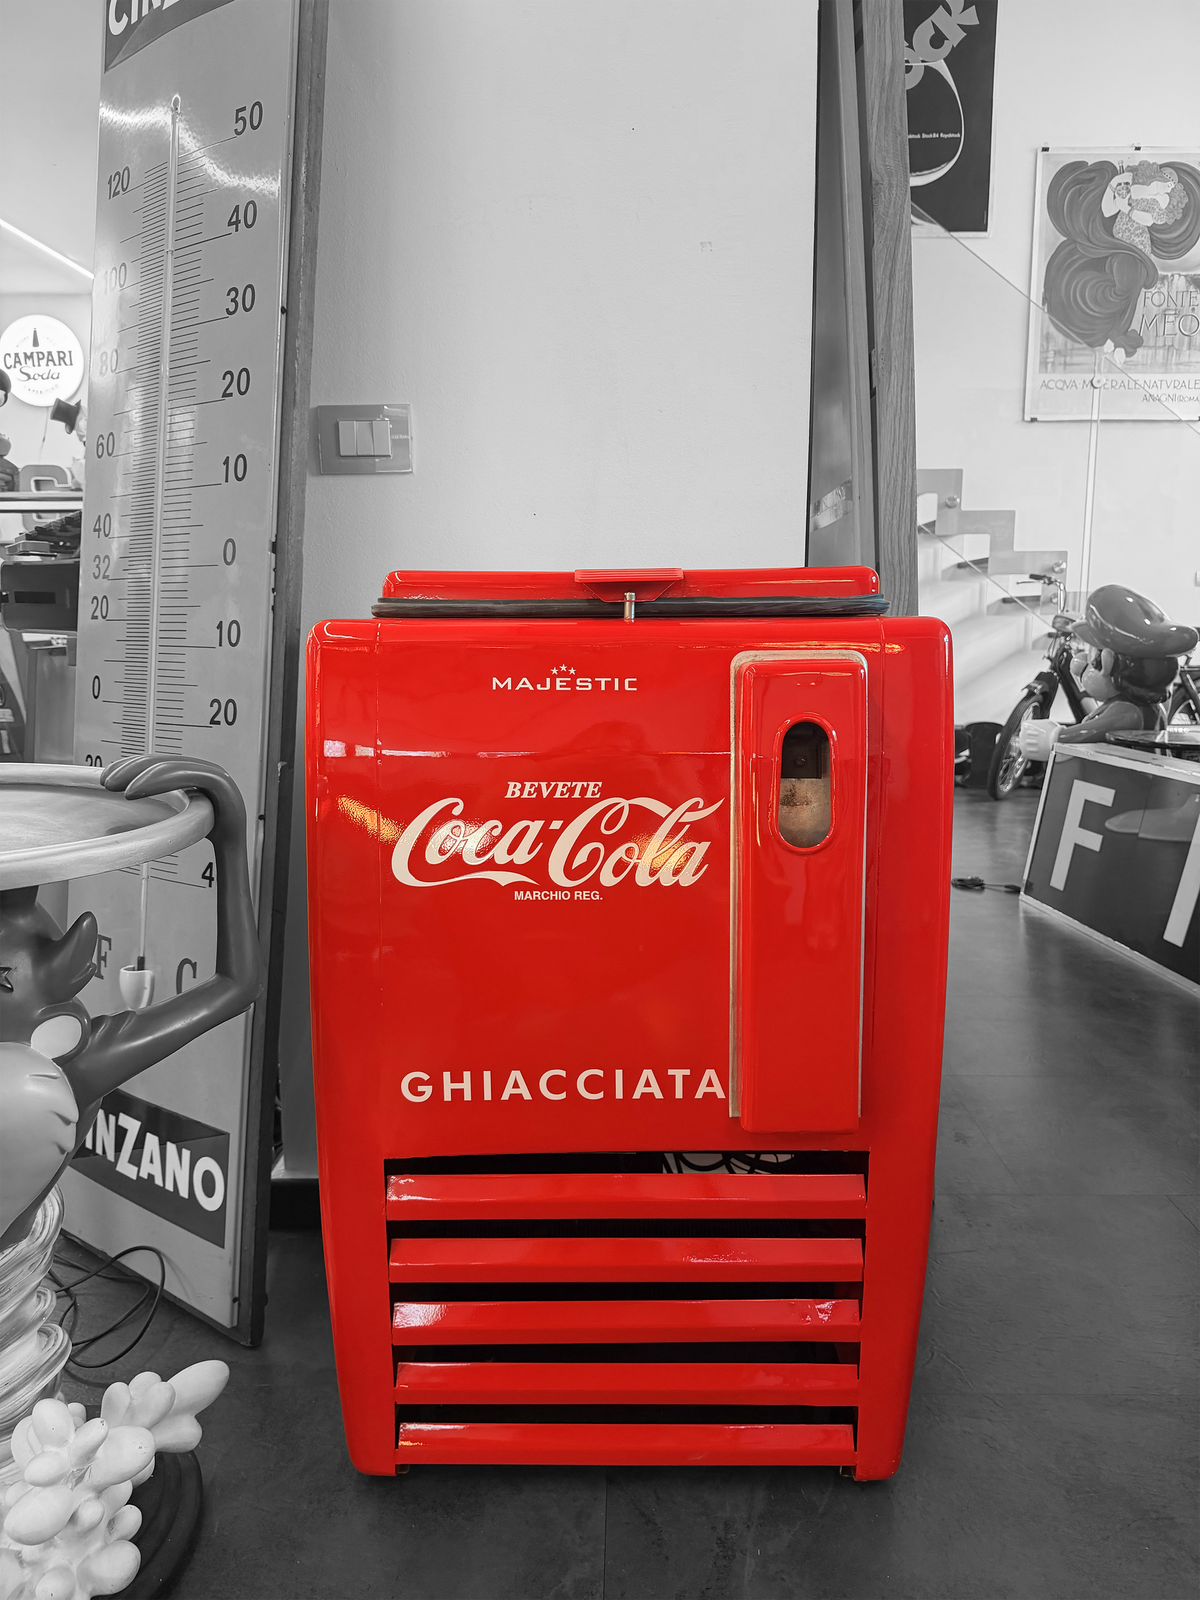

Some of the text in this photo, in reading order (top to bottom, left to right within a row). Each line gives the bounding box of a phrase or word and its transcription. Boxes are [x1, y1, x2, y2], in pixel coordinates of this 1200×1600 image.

[234, 101, 263, 136] 50
[108, 166, 130, 200] 120
[228, 200, 257, 233] 40
[226, 284, 256, 317] 30
[1143, 290, 1200, 308] FONTE
[3, 350, 73, 370] CAMPARI
[17, 366, 60, 382] Soda
[99, 347, 119, 378] 80
[221, 367, 251, 399] 20
[1081, 379, 1141, 391] MERALE
[96, 432, 115, 459] 60
[223, 454, 248, 483] 10
[93, 513, 112, 539] 40
[223, 538, 237, 566] 0
[92, 555, 111, 580] 32
[91, 595, 109, 620] 20
[216, 620, 241, 648] 10
[92, 675, 101, 700] 0
[492, 675, 638, 692] MAJESTIC
[209, 699, 238, 727] 20
[505, 781, 602, 799] BEVETE
[391, 796, 725, 887] Coca-Cola
[513, 889, 603, 901] MARCHIO REG.
[401, 1068, 726, 1103] GHIACCIATA
[85, 1108, 225, 1212] NZANO
